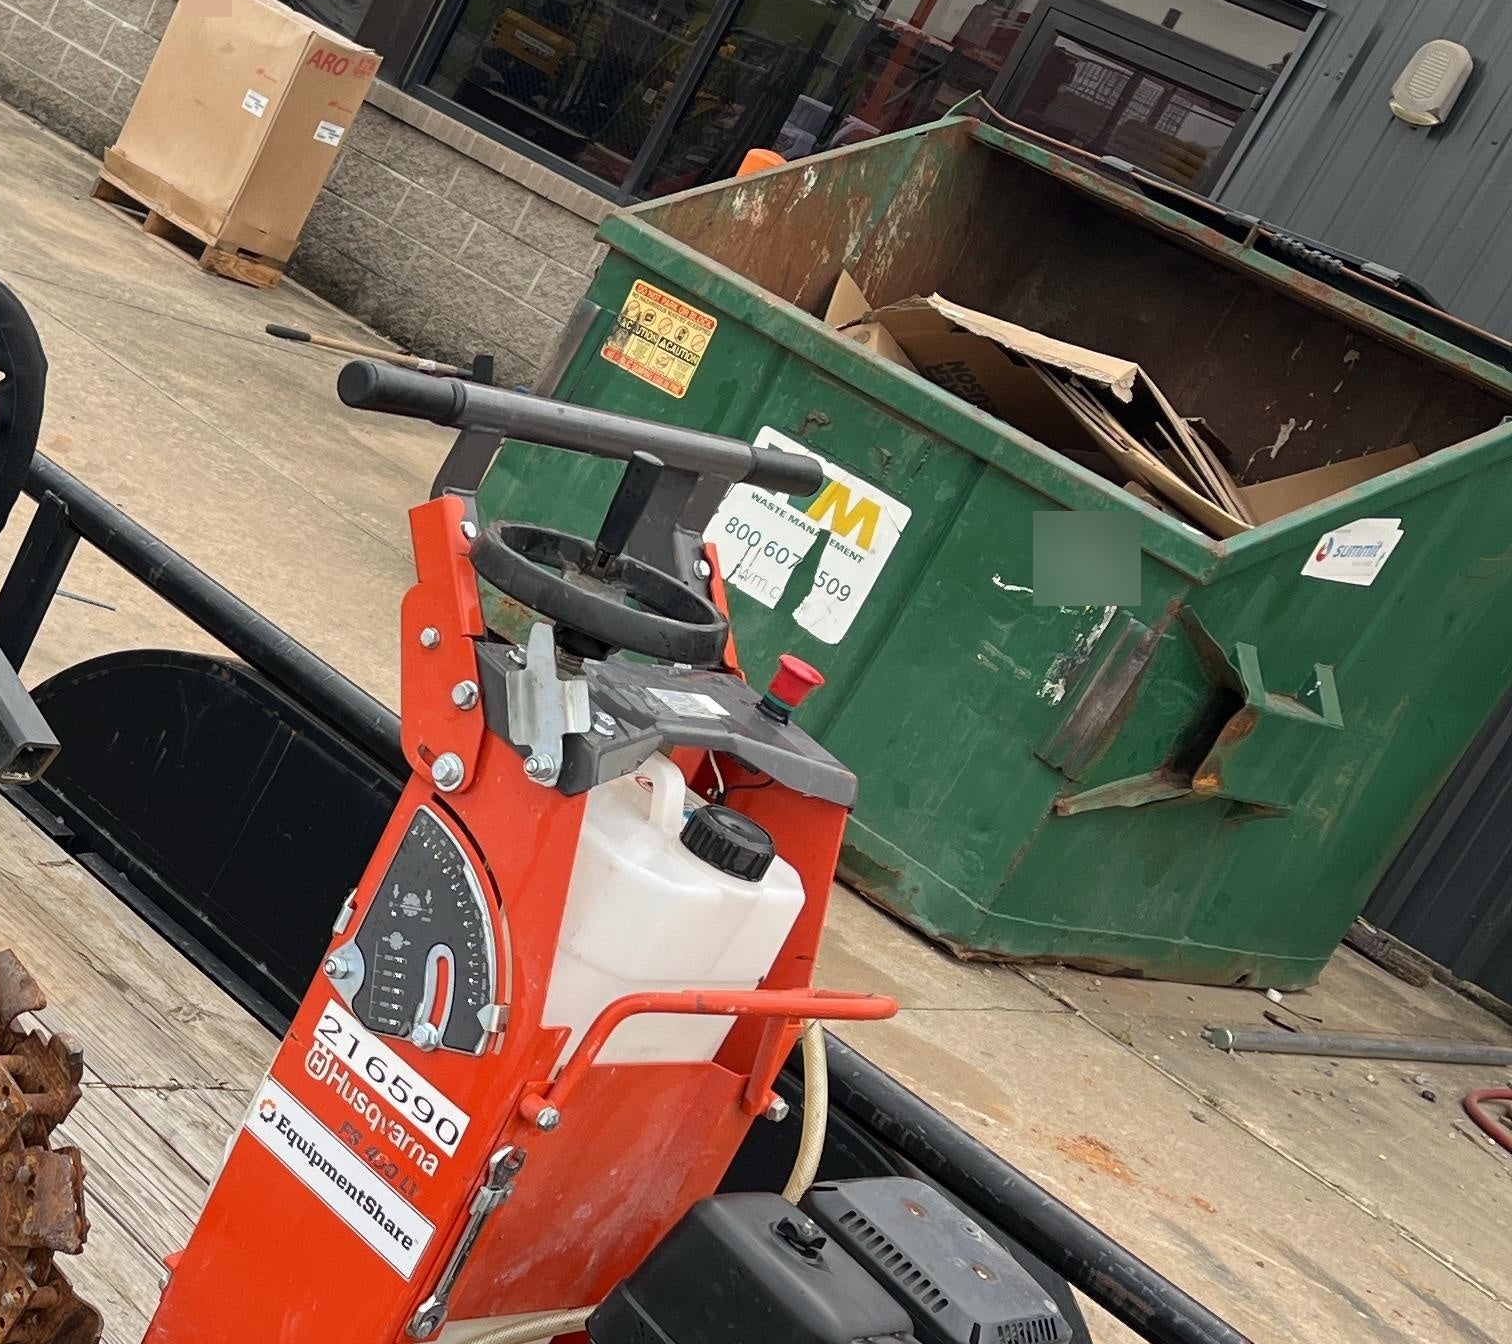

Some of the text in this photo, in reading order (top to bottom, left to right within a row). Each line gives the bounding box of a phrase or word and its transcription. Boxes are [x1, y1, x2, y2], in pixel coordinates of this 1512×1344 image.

[307, 48, 350, 76] ARO
[647, 290, 661, 302] NOT
[660, 297, 678, 311] PARK
[688, 311, 713, 328] BLOCK
[664, 340, 699, 364] CAUTION
[724, 516, 851, 602] 800 607 509
[751, 491, 865, 564] WASTE MANAEMENT
[1333, 541, 1383, 558] summit
[317, 1013, 460, 1146] 216590
[326, 1058, 440, 1177] Husqvarna
[272, 1113, 415, 1252] EquipmentShare
